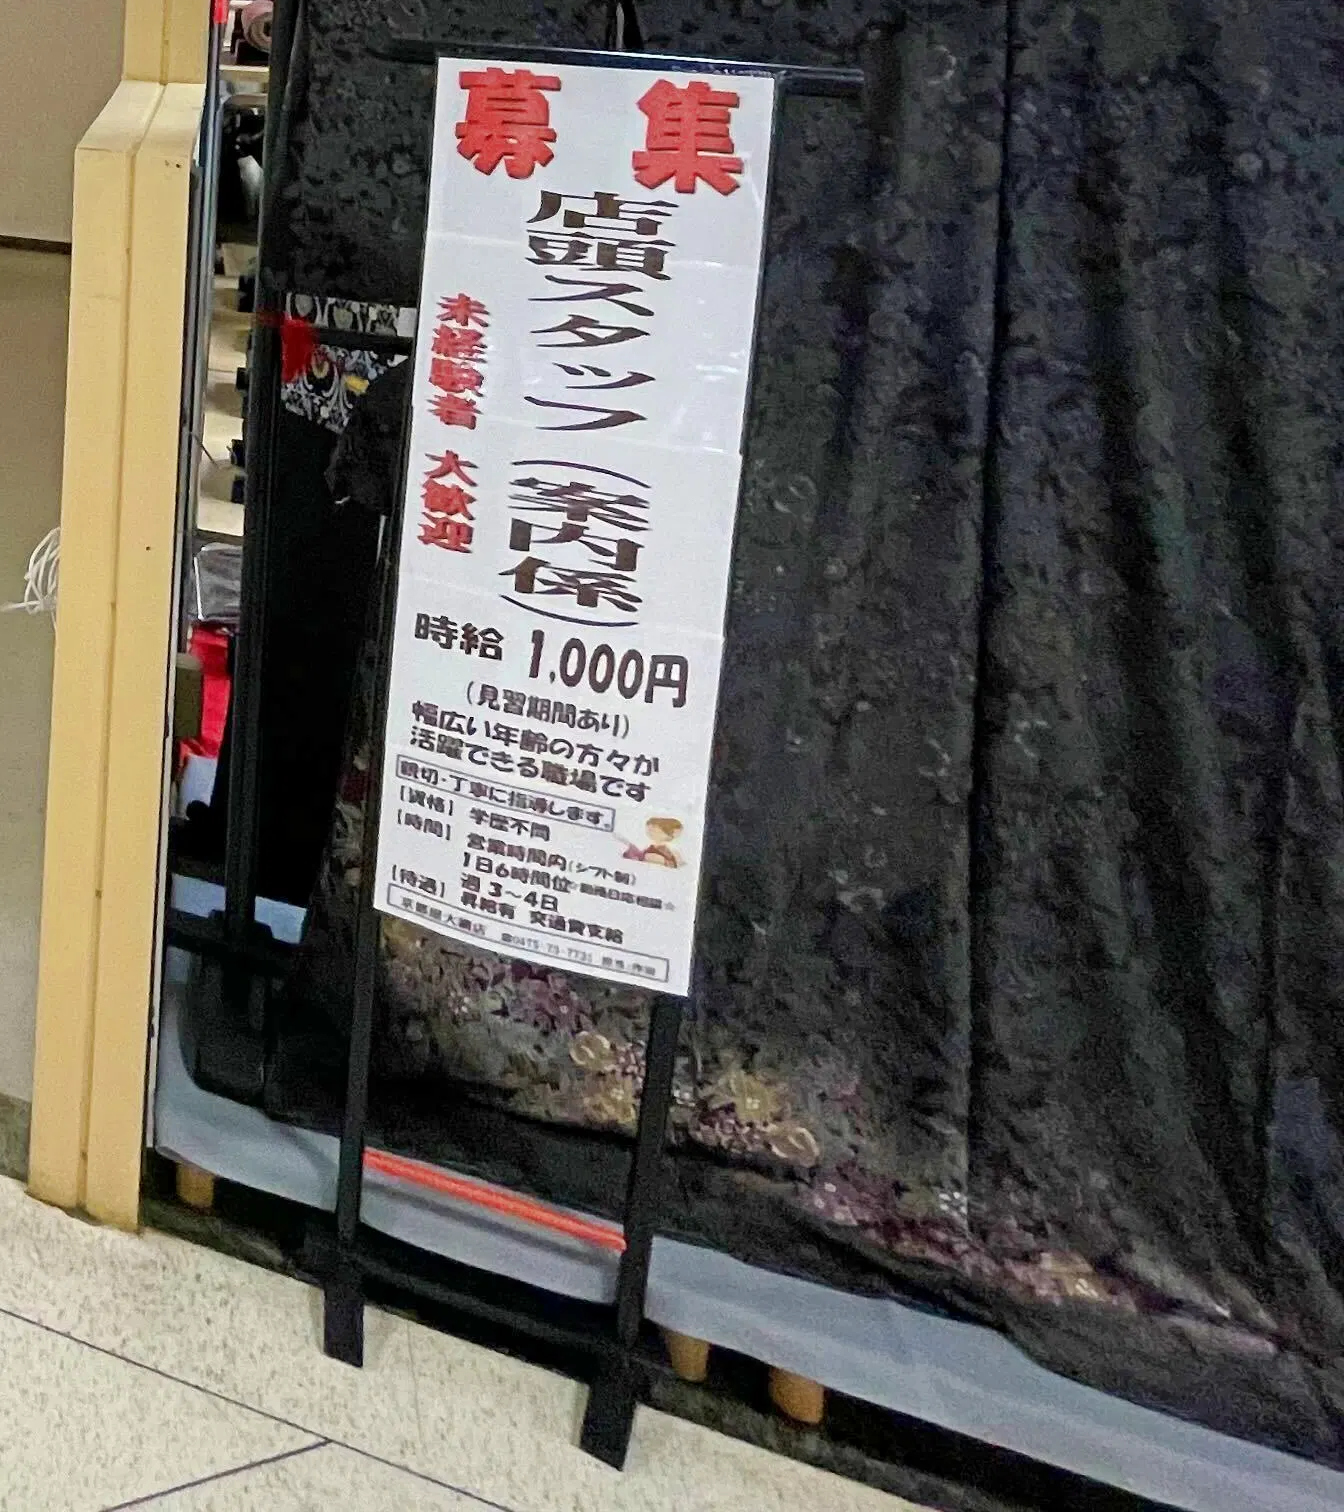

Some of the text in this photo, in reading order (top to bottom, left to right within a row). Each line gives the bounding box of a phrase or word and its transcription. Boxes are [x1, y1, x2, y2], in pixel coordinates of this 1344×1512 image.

[455, 66, 745, 197] 募集
[417, 293, 490, 554] 未経験者 大歓迎
[414, 612, 690, 709] 時給 1,000円
[409, 724, 652, 803] 活躍できる職場です
[411, 699, 660, 778] 幅広い年齢の方々が
